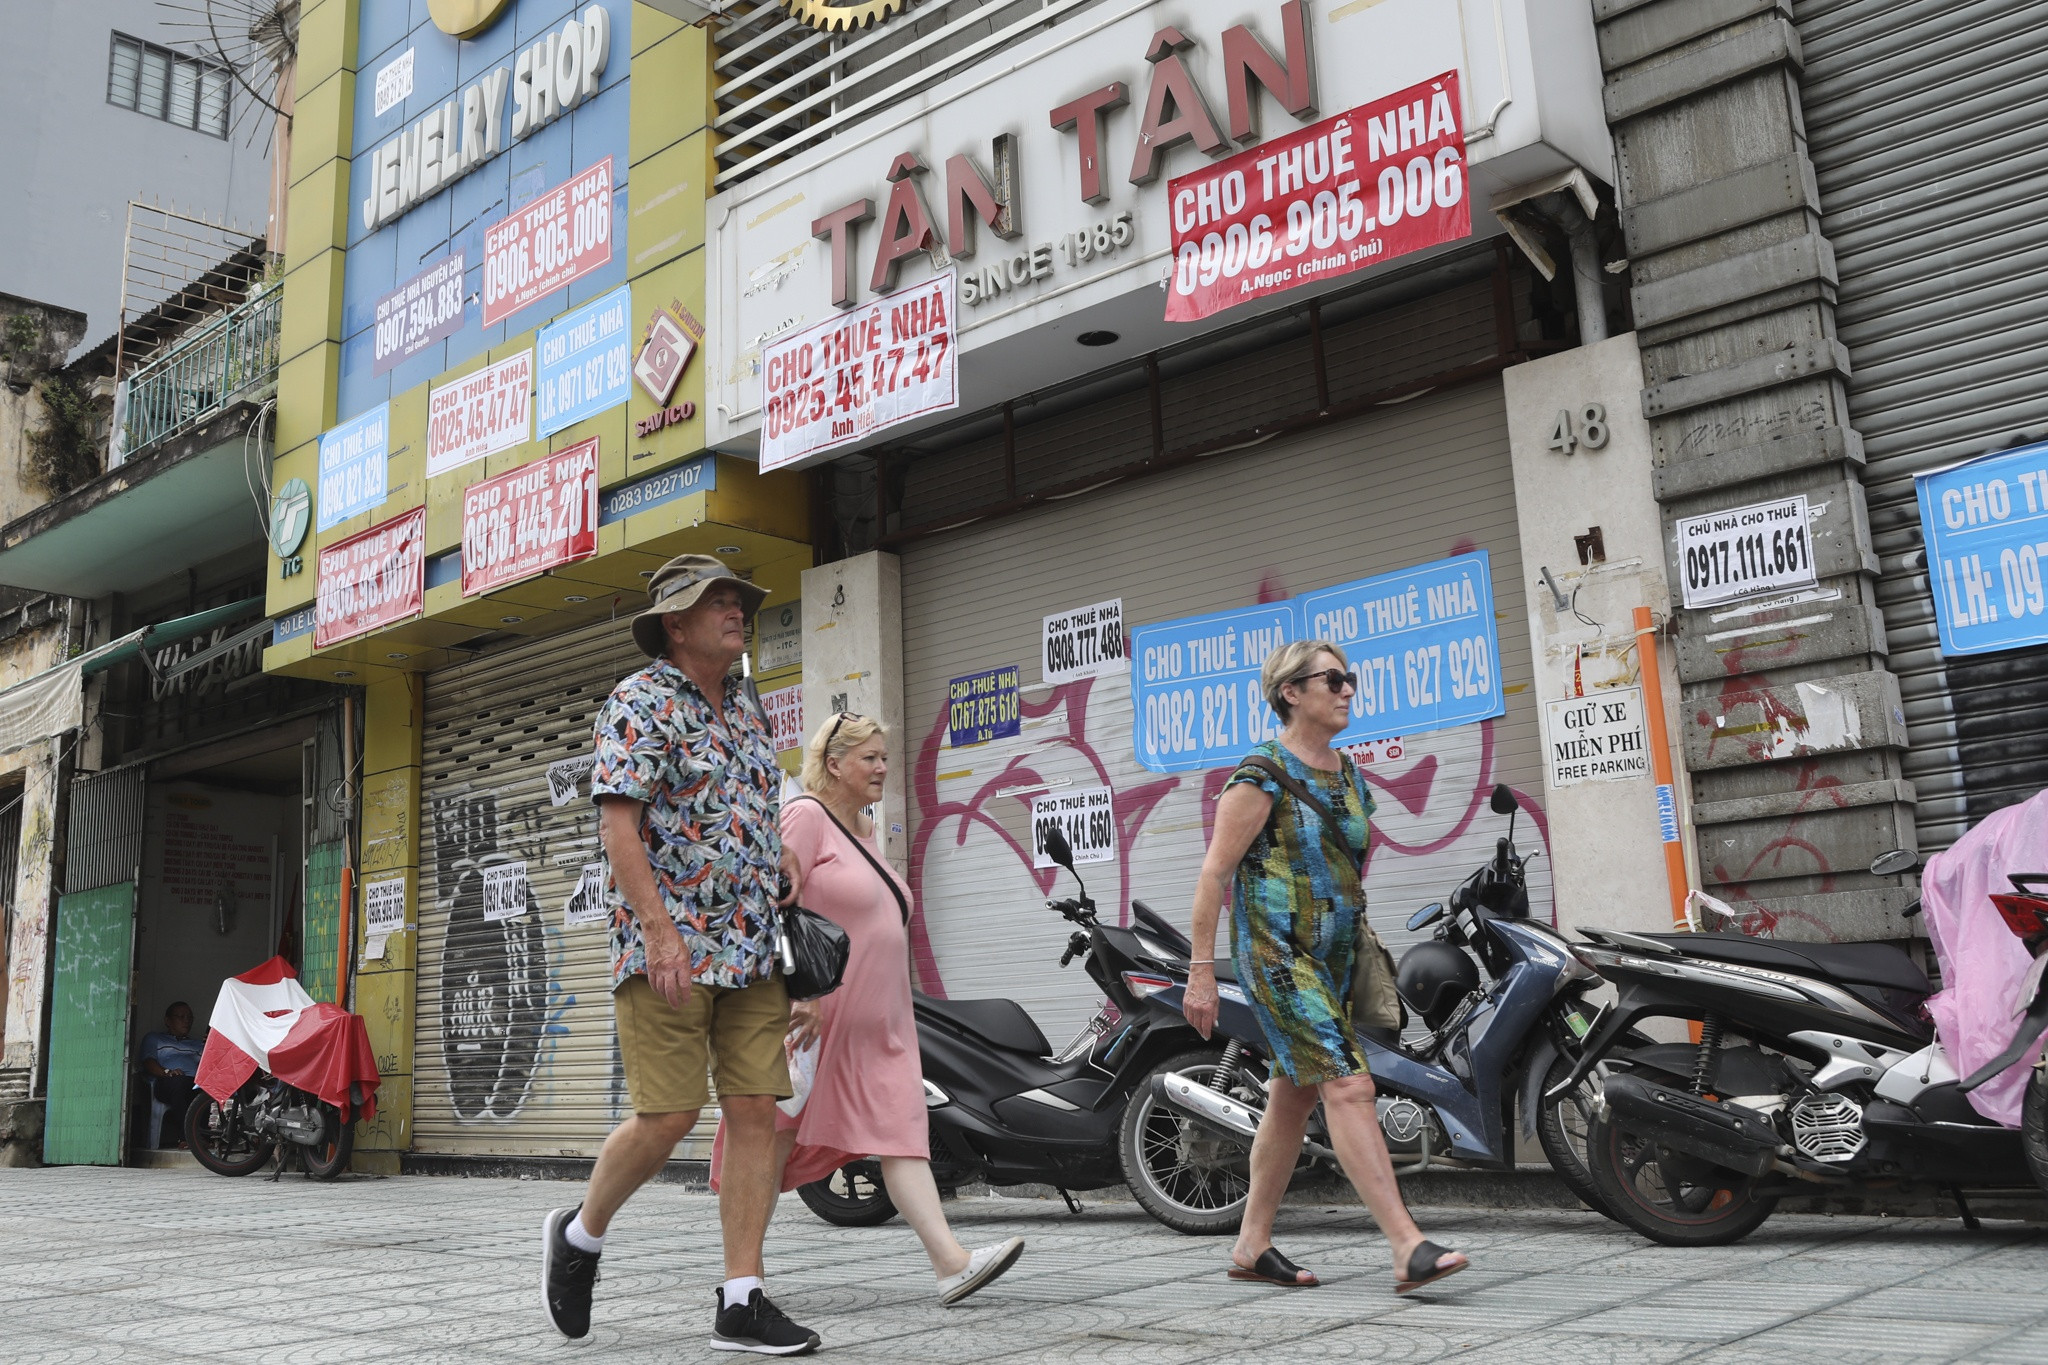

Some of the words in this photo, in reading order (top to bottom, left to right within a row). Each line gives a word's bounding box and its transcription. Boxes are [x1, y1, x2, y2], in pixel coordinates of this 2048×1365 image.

[364, 66, 510, 230] JEWELRY
[512, 5, 610, 140] SHOP
[812, 133, 1022, 309] TÂN
[1050, 0, 1320, 207] TÂN
[1173, 170, 1247, 235] CHO
[1257, 117, 1356, 203] THUÊ
[1367, 82, 1457, 164] NHÀ
[488, 221, 520, 255] CHO
[524, 190, 566, 233] THUÊ
[571, 166, 608, 206] NHÀ
[1175, 146, 1464, 296] 0906.905.006
[486, 191, 609, 305] 0906.905.006
[959, 242, 1054, 307] SINCE
[1058, 211, 1135, 270] 1985
[1240, 269, 1292, 295] A.Ngọc
[1296, 251, 1347, 279] (chính
[1350, 238, 1383, 264] chủ)
[375, 274, 462, 361] 0907.594.883
[376, 300, 390, 321] CHO
[391, 287, 406, 313] THUÊ
[406, 278, 420, 302] NHÀ
[543, 334, 566, 366] CHO
[568, 313, 597, 353] THUÊ
[600, 301, 624, 337] NHÀ
[767, 342, 814, 394] CHO
[820, 307, 882, 370] THUÊ
[891, 285, 947, 346] NHÀ
[432, 390, 458, 414] CHO
[462, 371, 495, 402] THUÊ
[499, 357, 529, 387] NHÀ
[541, 378, 556, 421] LH:
[558, 365, 582, 414] 0971
[585, 353, 605, 401] 627
[606, 343, 627, 391] 929
[767, 332, 949, 440] 0925.45.47.47
[324, 441, 341, 470] CHO
[343, 425, 364, 461] THUÊ
[365, 415, 383, 450] NHÀ
[430, 379, 529, 459] 0925.45.47.47
[634, 400, 697, 438] SAVICO
[831, 420, 854, 440] Anh
[1546, 401, 1610, 455] 48
[323, 470, 345, 519] 0982
[346, 461, 362, 508] 821
[364, 451, 382, 499] 829
[467, 486, 501, 516] CHO
[506, 463, 550, 501] THUÊ
[555, 446, 595, 484] NHÀ
[610, 488, 642, 515] 0283
[644, 464, 702, 502] 8227107
[1941, 478, 2011, 530] CHO
[465, 473, 595, 574] 0936.445.201
[1688, 518, 1711, 537] CHỦ
[1714, 515, 1738, 532] NHÀ
[1741, 512, 1764, 527] CHO
[1767, 502, 1798, 522] THUÊ
[280, 555, 304, 580] ITC
[321, 547, 349, 576] CHO
[352, 529, 388, 564] THUÊ
[1687, 525, 1808, 590] 0917.111.661
[1048, 617, 1068, 634] CHO
[1071, 607, 1096, 629] THUÊ
[1099, 602, 1120, 622] NHÀ
[1314, 606, 1358, 642] CHO
[1363, 584, 1422, 635] THUÊ
[1426, 572, 1479, 621] NHÀ
[1944, 553, 1998, 629] LH:
[279, 620, 291, 637] 50
[292, 611, 305, 631] LÊ
[1047, 620, 1122, 673] 0908.777.488
[1144, 642, 1183, 681] CHO
[1187, 626, 1237, 675] THUÊ
[1243, 618, 1285, 667] NHÀ
[760, 695, 774, 712] HO
[775, 687, 795, 710] THUÊ
[950, 680, 970, 700] CHO
[971, 671, 996, 695] THUÊ
[998, 667, 1018, 690] NHÀ
[1350, 654, 1399, 719] 0971
[1404, 645, 1442, 709] 627
[1448, 635, 1490, 700] 929
[781, 708, 796, 738] 545
[951, 700, 976, 732] 0767
[978, 696, 997, 727] 875
[999, 691, 1018, 723] 618
[1145, 688, 1197, 755] 0982
[1201, 683, 1239, 749] 821
[1247, 679, 1286, 744] 82
[1564, 702, 1597, 730] GIỮ
[1602, 702, 1627, 724] XE
[1353, 750, 1375, 765] Thành
[1554, 729, 1603, 762] MIỄN
[1608, 725, 1643, 754] PHÍ
[1557, 763, 1588, 781] FREE
[1591, 756, 1645, 777] PARKING
[1036, 799, 1057, 813] CHO
[1060, 793, 1085, 810] THUÊ
[1088, 789, 1109, 807] NHÀ
[368, 887, 380, 900] CHO
[380, 881, 393, 898] THUÊ
[485, 877, 526, 913] 0931.432.469
[486, 871, 498, 881] CHO
[499, 866, 513, 879] THUÊ
[513, 863, 525, 877] NHÀ
[585, 865, 601, 879] THUÊ
